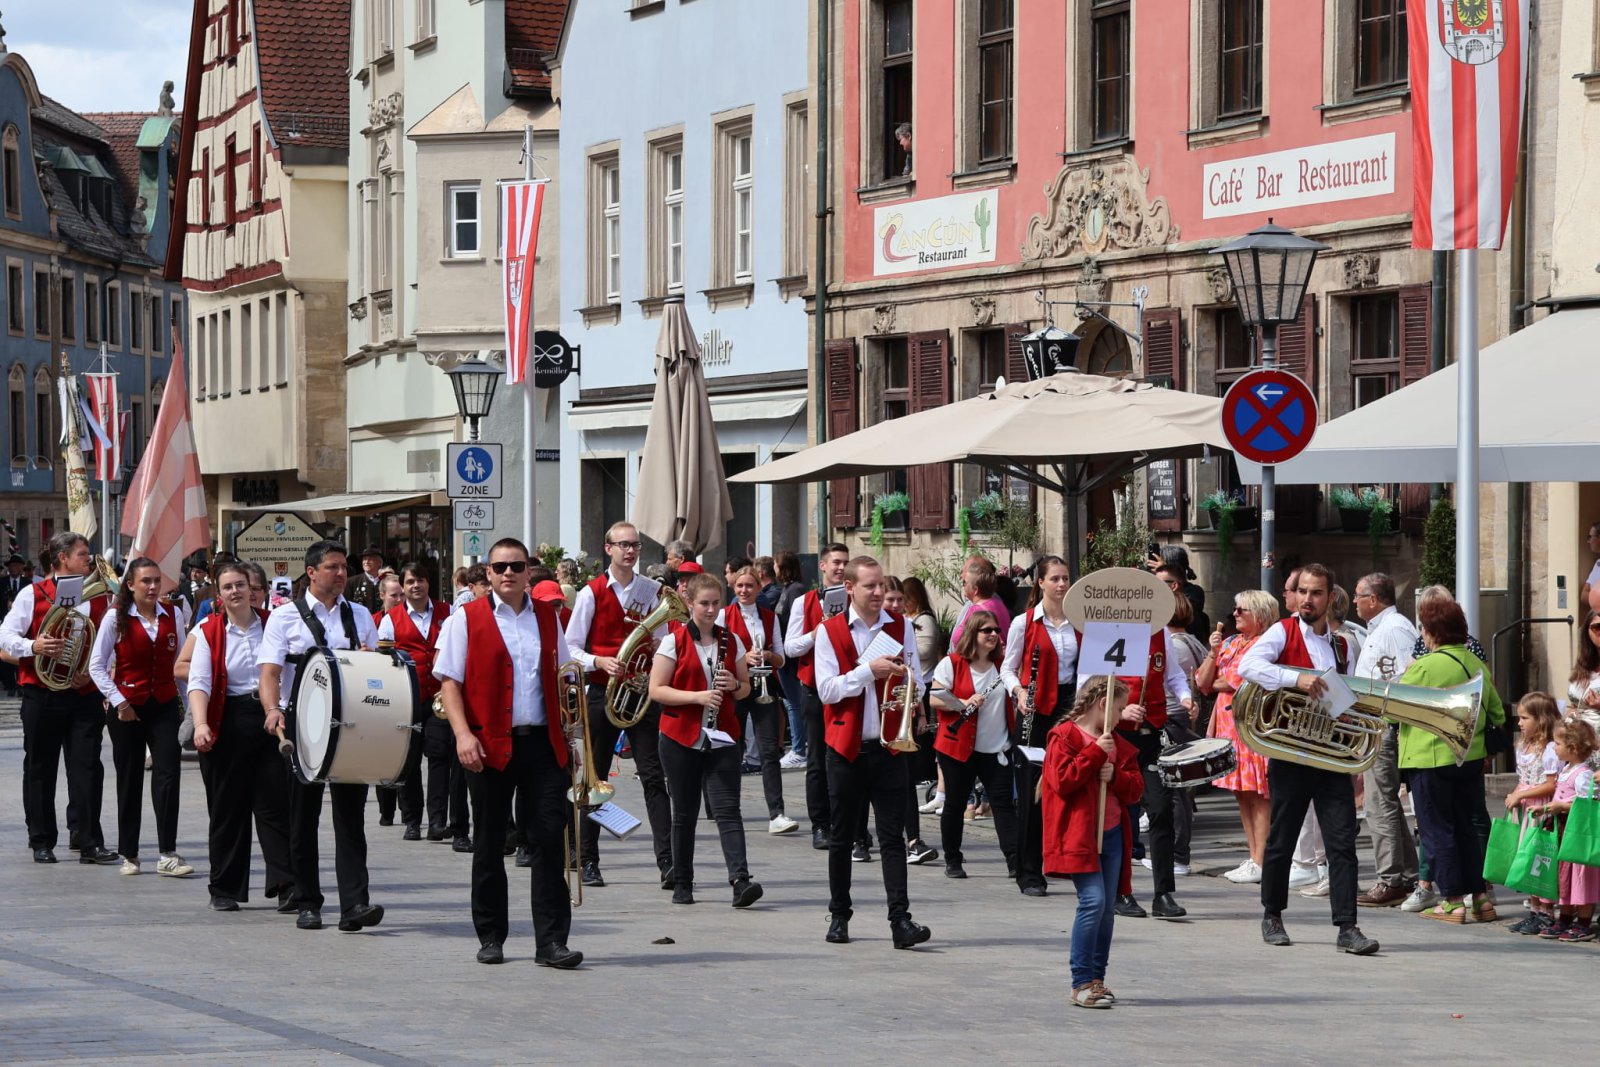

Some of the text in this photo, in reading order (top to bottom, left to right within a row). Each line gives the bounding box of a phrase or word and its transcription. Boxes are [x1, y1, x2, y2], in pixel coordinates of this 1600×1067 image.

[1208, 150, 1389, 207] Café Bar Restaurant
[918, 246, 968, 264] Restaurant
[460, 485, 489, 495] ZONE
[276, 581, 291, 598] 5
[1083, 585, 1154, 602] Stadtkapelle
[1083, 605, 1153, 623] Weißenburg
[1103, 638, 1127, 668] 4
